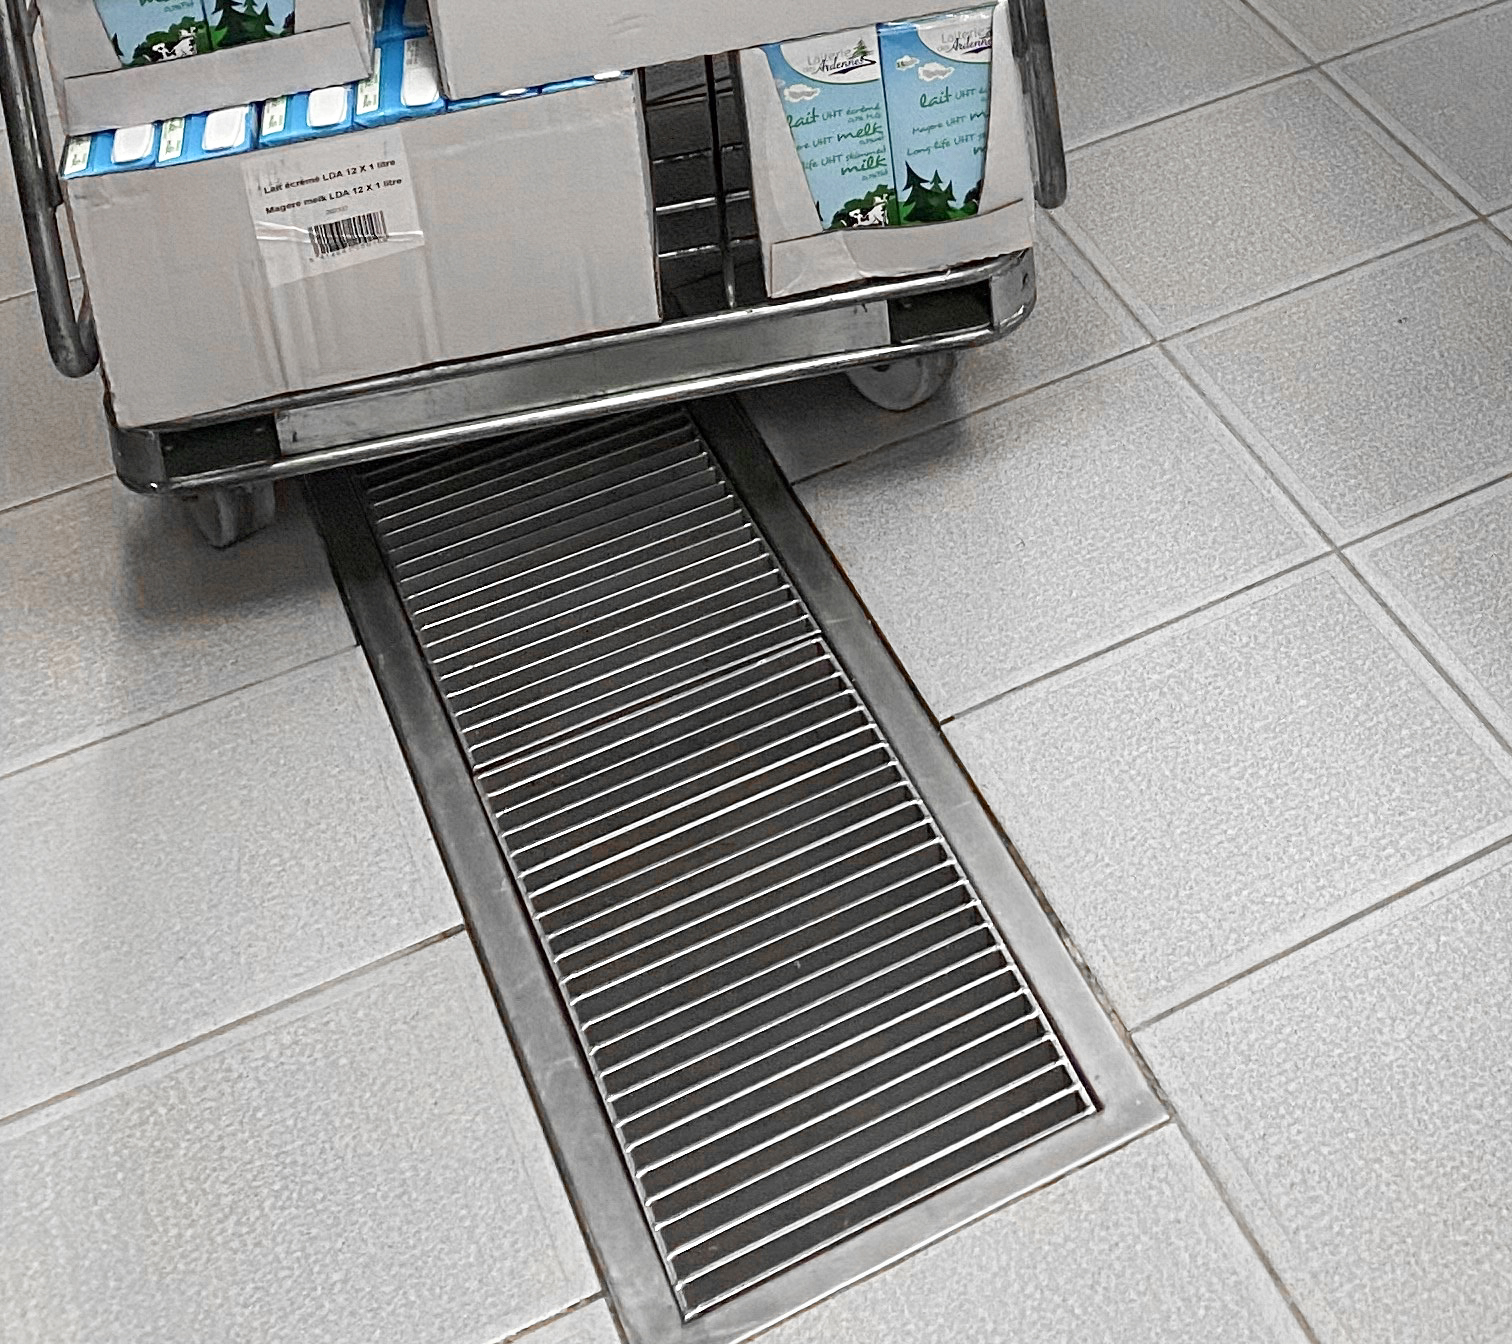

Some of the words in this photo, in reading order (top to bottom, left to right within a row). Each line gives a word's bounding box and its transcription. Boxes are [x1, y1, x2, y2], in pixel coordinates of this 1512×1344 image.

[920, 86, 952, 108] lait
[322, 170, 343, 182] LDA
[346, 166, 357, 176] 12
[359, 165, 367, 173] X
[369, 163, 375, 171] 1
[841, 155, 889, 175] milk
[329, 188, 350, 201] LDA
[352, 186, 364, 195] 12
[366, 183, 373, 192] X
[375, 182, 381, 190] 1
[383, 177, 402, 188] litre
